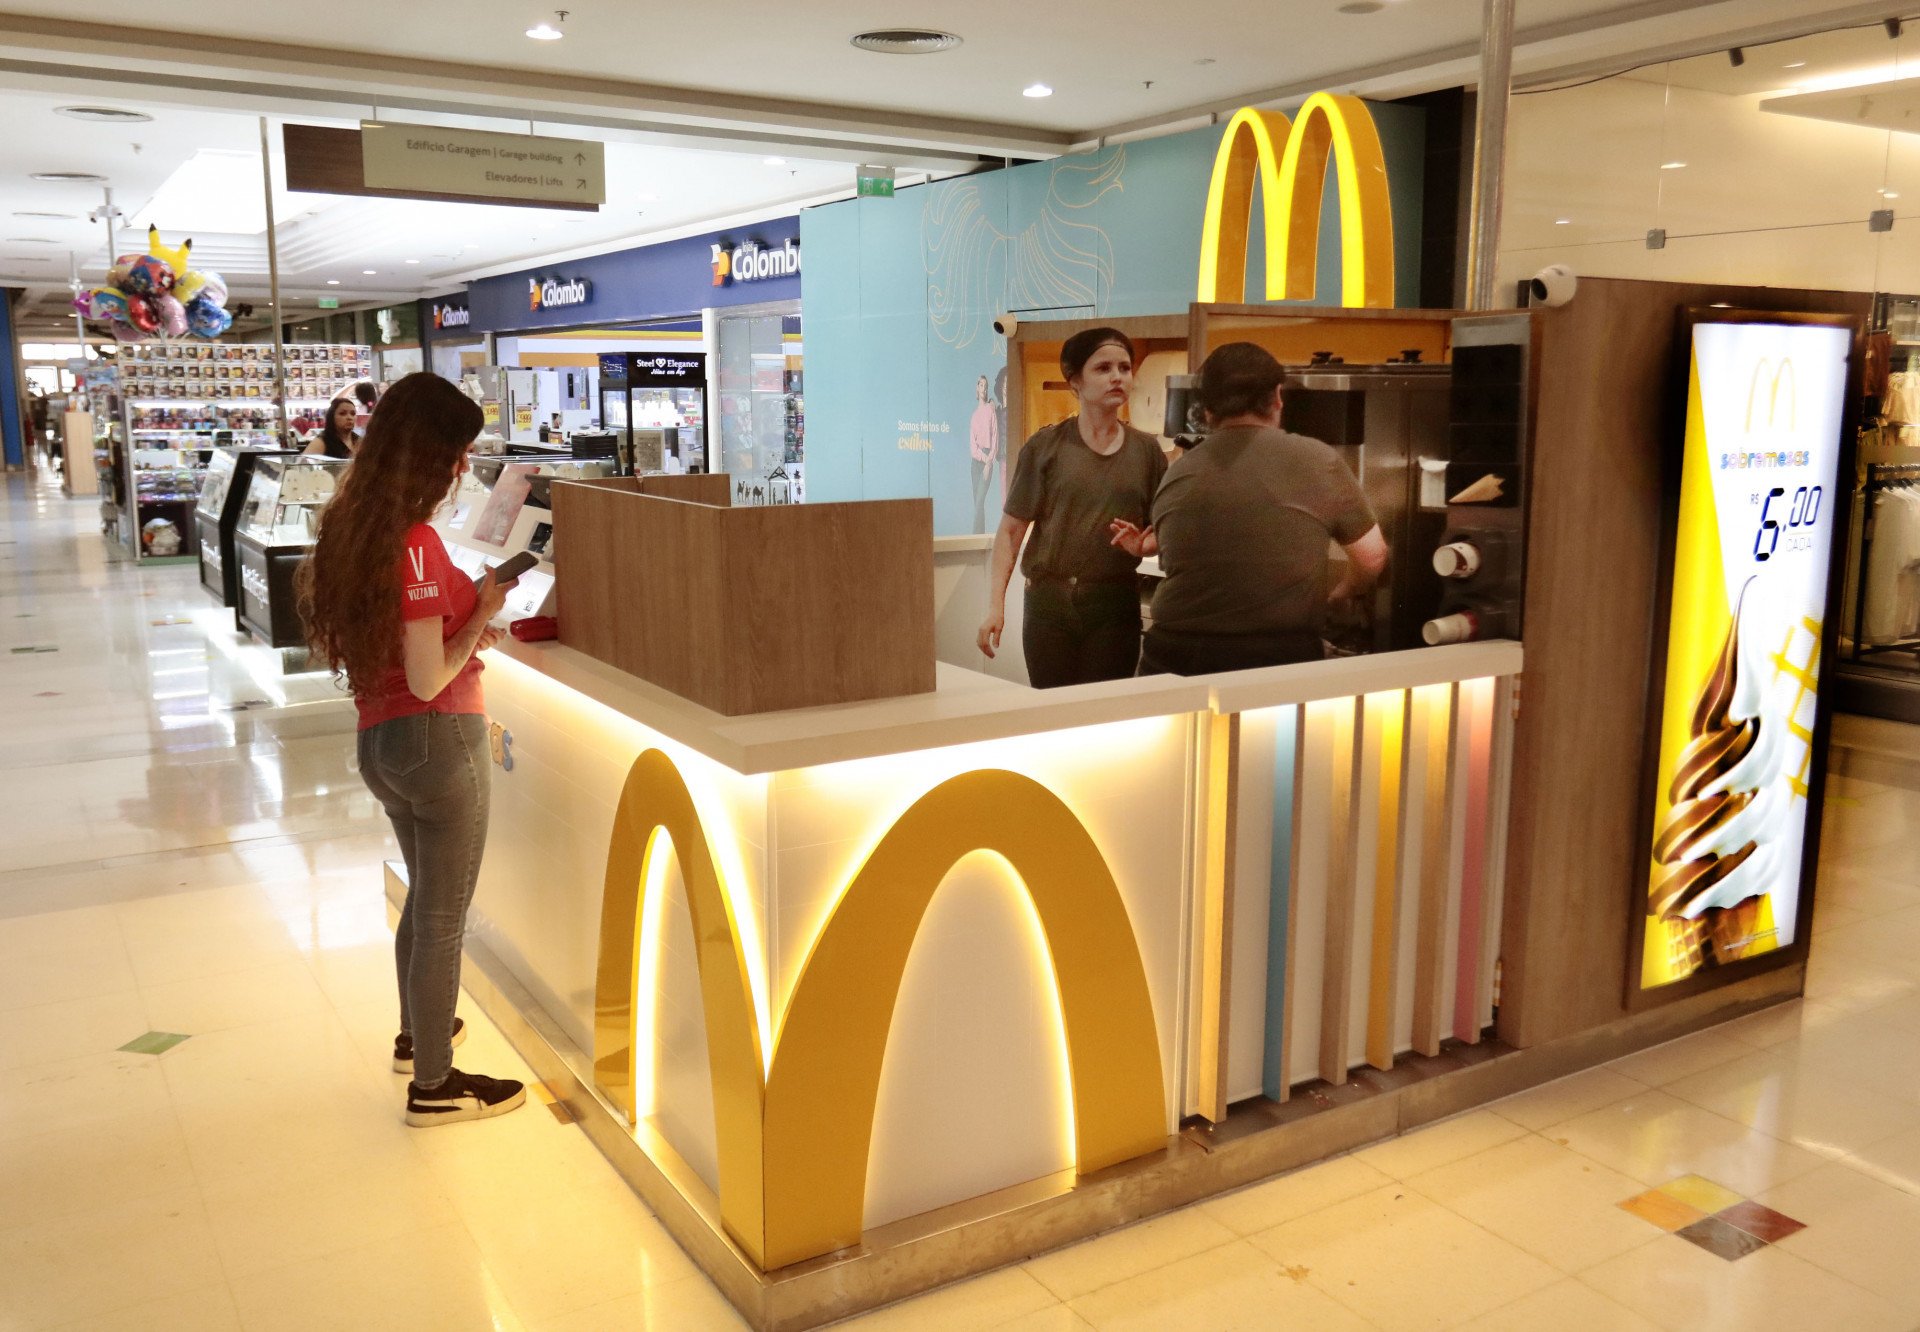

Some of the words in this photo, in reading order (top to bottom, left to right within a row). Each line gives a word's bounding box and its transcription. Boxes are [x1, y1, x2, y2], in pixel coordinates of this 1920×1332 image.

[447, 143, 491, 158] Garagem
[499, 148, 528, 161] Garage
[530, 152, 563, 165] building
[485, 171, 538, 185] Elevadores
[545, 176, 563, 187] Lifts
[542, 279, 585, 307] Colombo
[442, 306, 469, 327] Colombo
[636, 359, 655, 368] Steel
[667, 359, 699, 371] Elegance
[898, 420, 920, 431] Somos
[940, 421, 950, 432] de
[1720, 449, 1810, 469] sobremesas
[408, 546, 424, 582] V
[407, 585, 439, 601] VIZZANO
